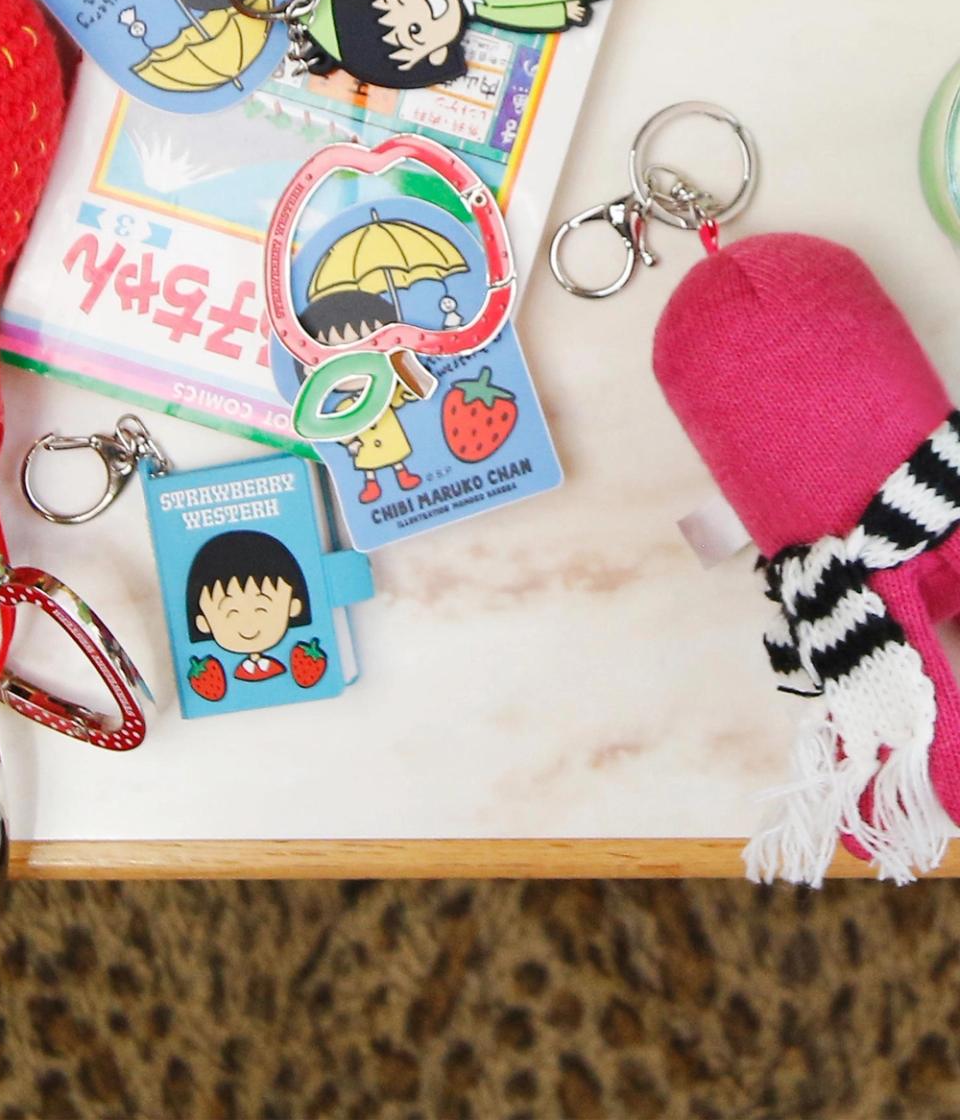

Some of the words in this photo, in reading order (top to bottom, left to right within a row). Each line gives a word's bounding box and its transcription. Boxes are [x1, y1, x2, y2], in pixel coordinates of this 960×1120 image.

[115, 213, 136, 237] 3
[171, 382, 253, 419] COMICS
[160, 473, 295, 511] STRAWBERRY
[371, 499, 414, 524] CHIBI
[418, 475, 481, 508] MARUKO
[488, 458, 532, 484] CHAN
